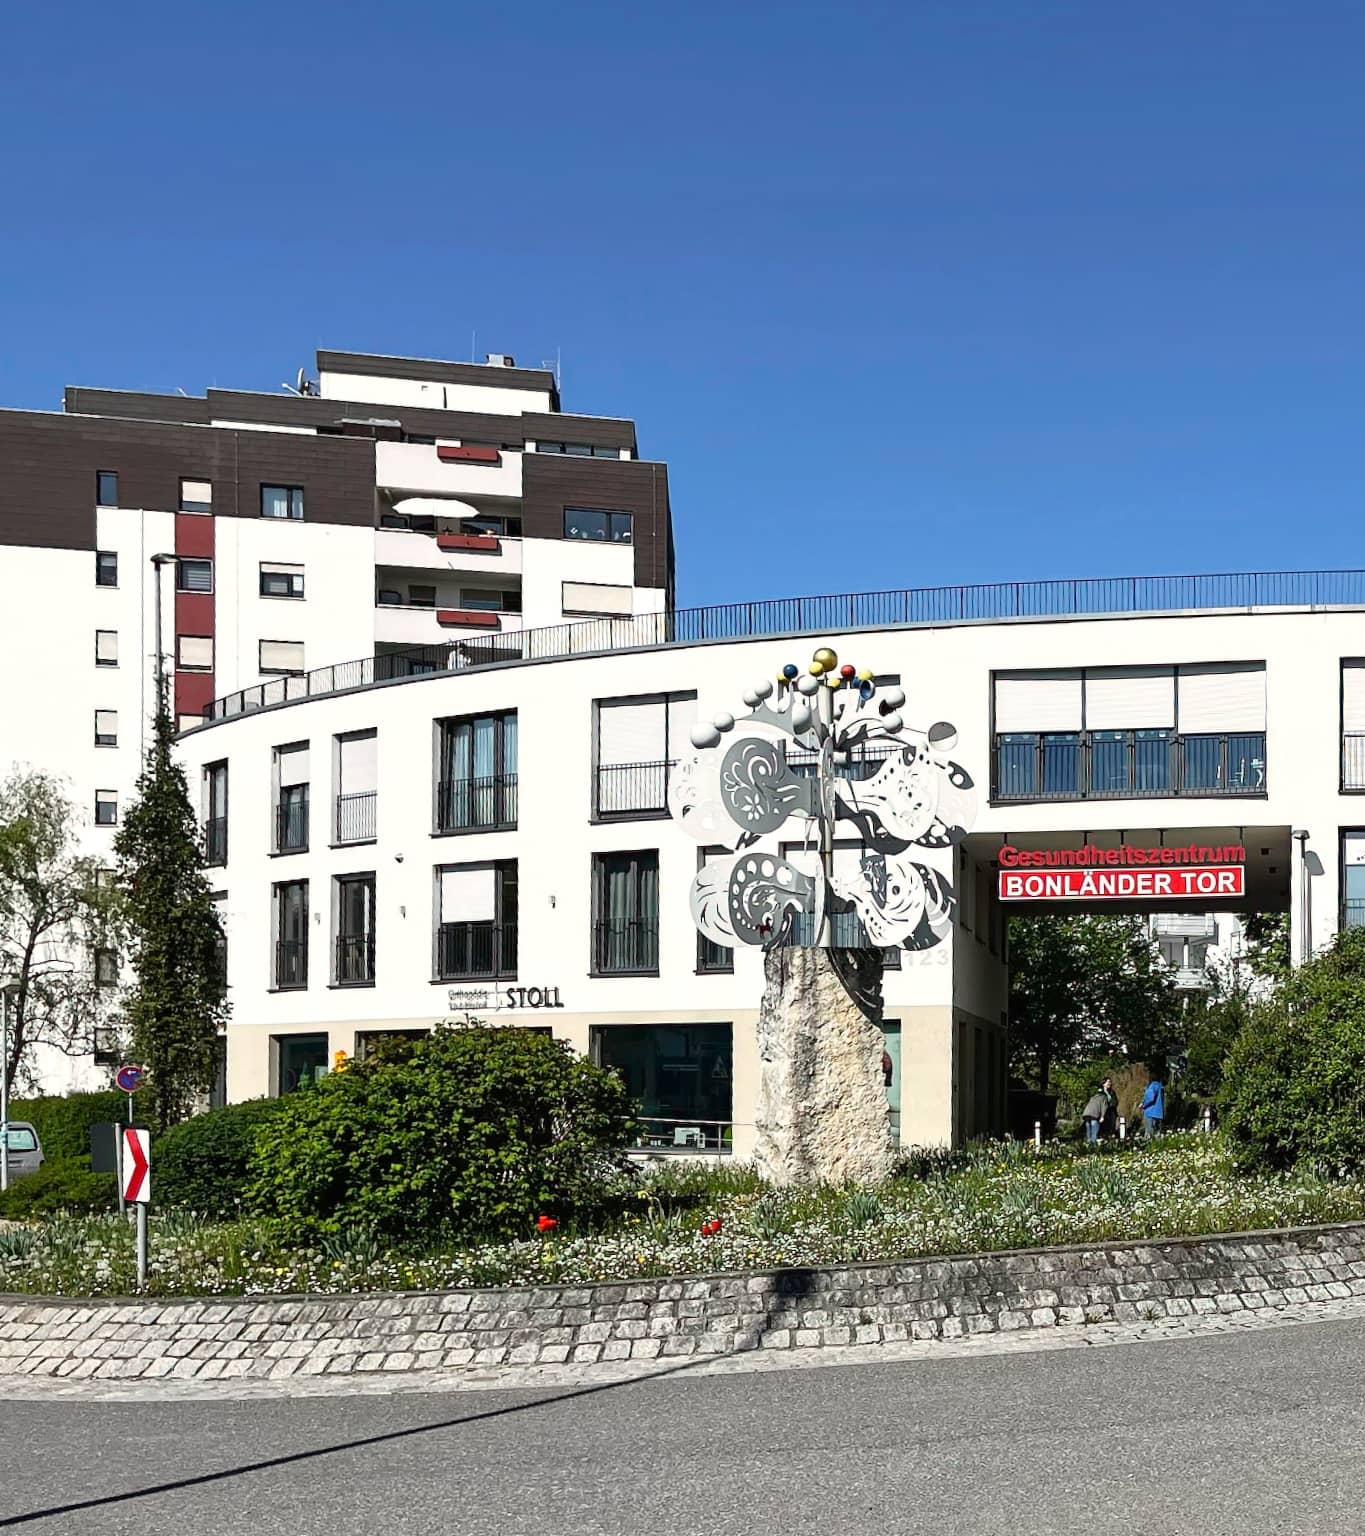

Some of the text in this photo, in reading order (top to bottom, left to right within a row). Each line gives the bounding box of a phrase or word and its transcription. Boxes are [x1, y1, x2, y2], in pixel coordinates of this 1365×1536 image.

[1000, 844, 1246, 867] Gesundheitszentrum
[1006, 871, 1236, 897] BONLÄNDER TOR
[904, 949, 949, 966] 123
[507, 987, 565, 1009] STOLL
